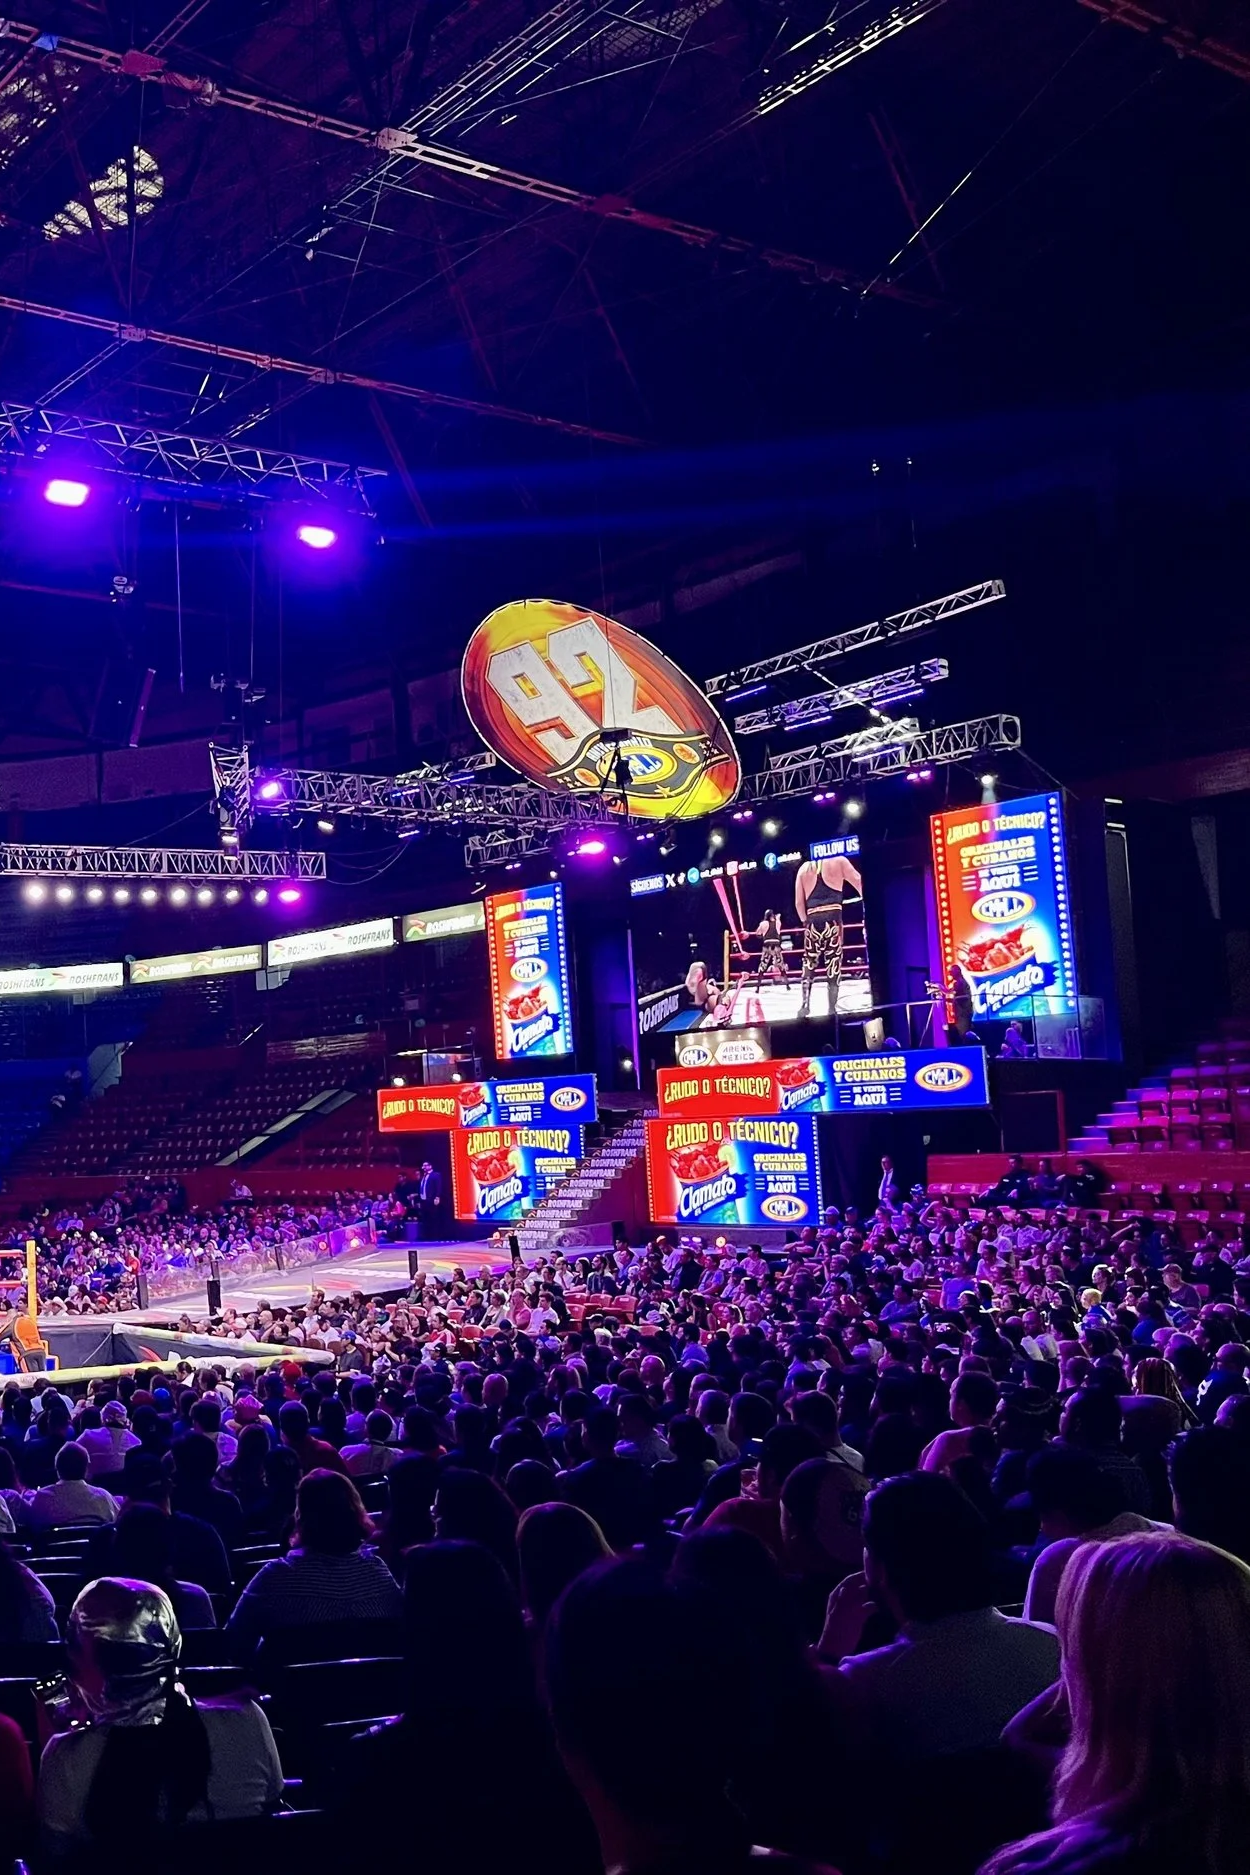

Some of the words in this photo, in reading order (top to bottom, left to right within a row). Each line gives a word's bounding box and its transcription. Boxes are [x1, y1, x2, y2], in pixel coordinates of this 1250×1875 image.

[486, 617, 685, 766] 92
[813, 842, 845, 858] FOLLOW
[846, 838, 860, 852] US
[961, 858, 971, 869] Y
[972, 846, 1036, 866] CUBANOS
[348, 929, 391, 945] ROSHFRANS
[972, 964, 1044, 1014] Clamato
[833, 1056, 906, 1071] ORIGINALES
[834, 1072, 843, 1083] Y
[844, 1068, 907, 1082] CUBANOS
[496, 1095, 503, 1103] Y
[503, 1092, 545, 1103] CUBANOS
[664, 1080, 699, 1104] ¿RUDO
[702, 1079, 710, 1094] O
[714, 1076, 771, 1099] TÉCNICO?
[781, 1082, 820, 1110] Clamato
[854, 1093, 888, 1106] AQUÍ
[408, 1099, 414, 1112] O
[417, 1097, 455, 1116] TÉCNICO?
[467, 1131, 500, 1156] ¿RUDO
[503, 1130, 511, 1147] O
[515, 1127, 570, 1154] TÉCNICO?
[666, 1122, 709, 1150] ¿RUDO
[713, 1121, 723, 1142] O
[728, 1118, 799, 1150] TÉCNICO?
[601, 1148, 637, 1157] ROSHFRANS
[753, 1153, 807, 1162] ORIGINALES
[754, 1163, 763, 1171] Y
[763, 1162, 807, 1171] CUBANOS
[477, 1177, 522, 1215] Clamato
[680, 1174, 736, 1217] Clamato
[767, 1181, 797, 1193] AQUÍ
